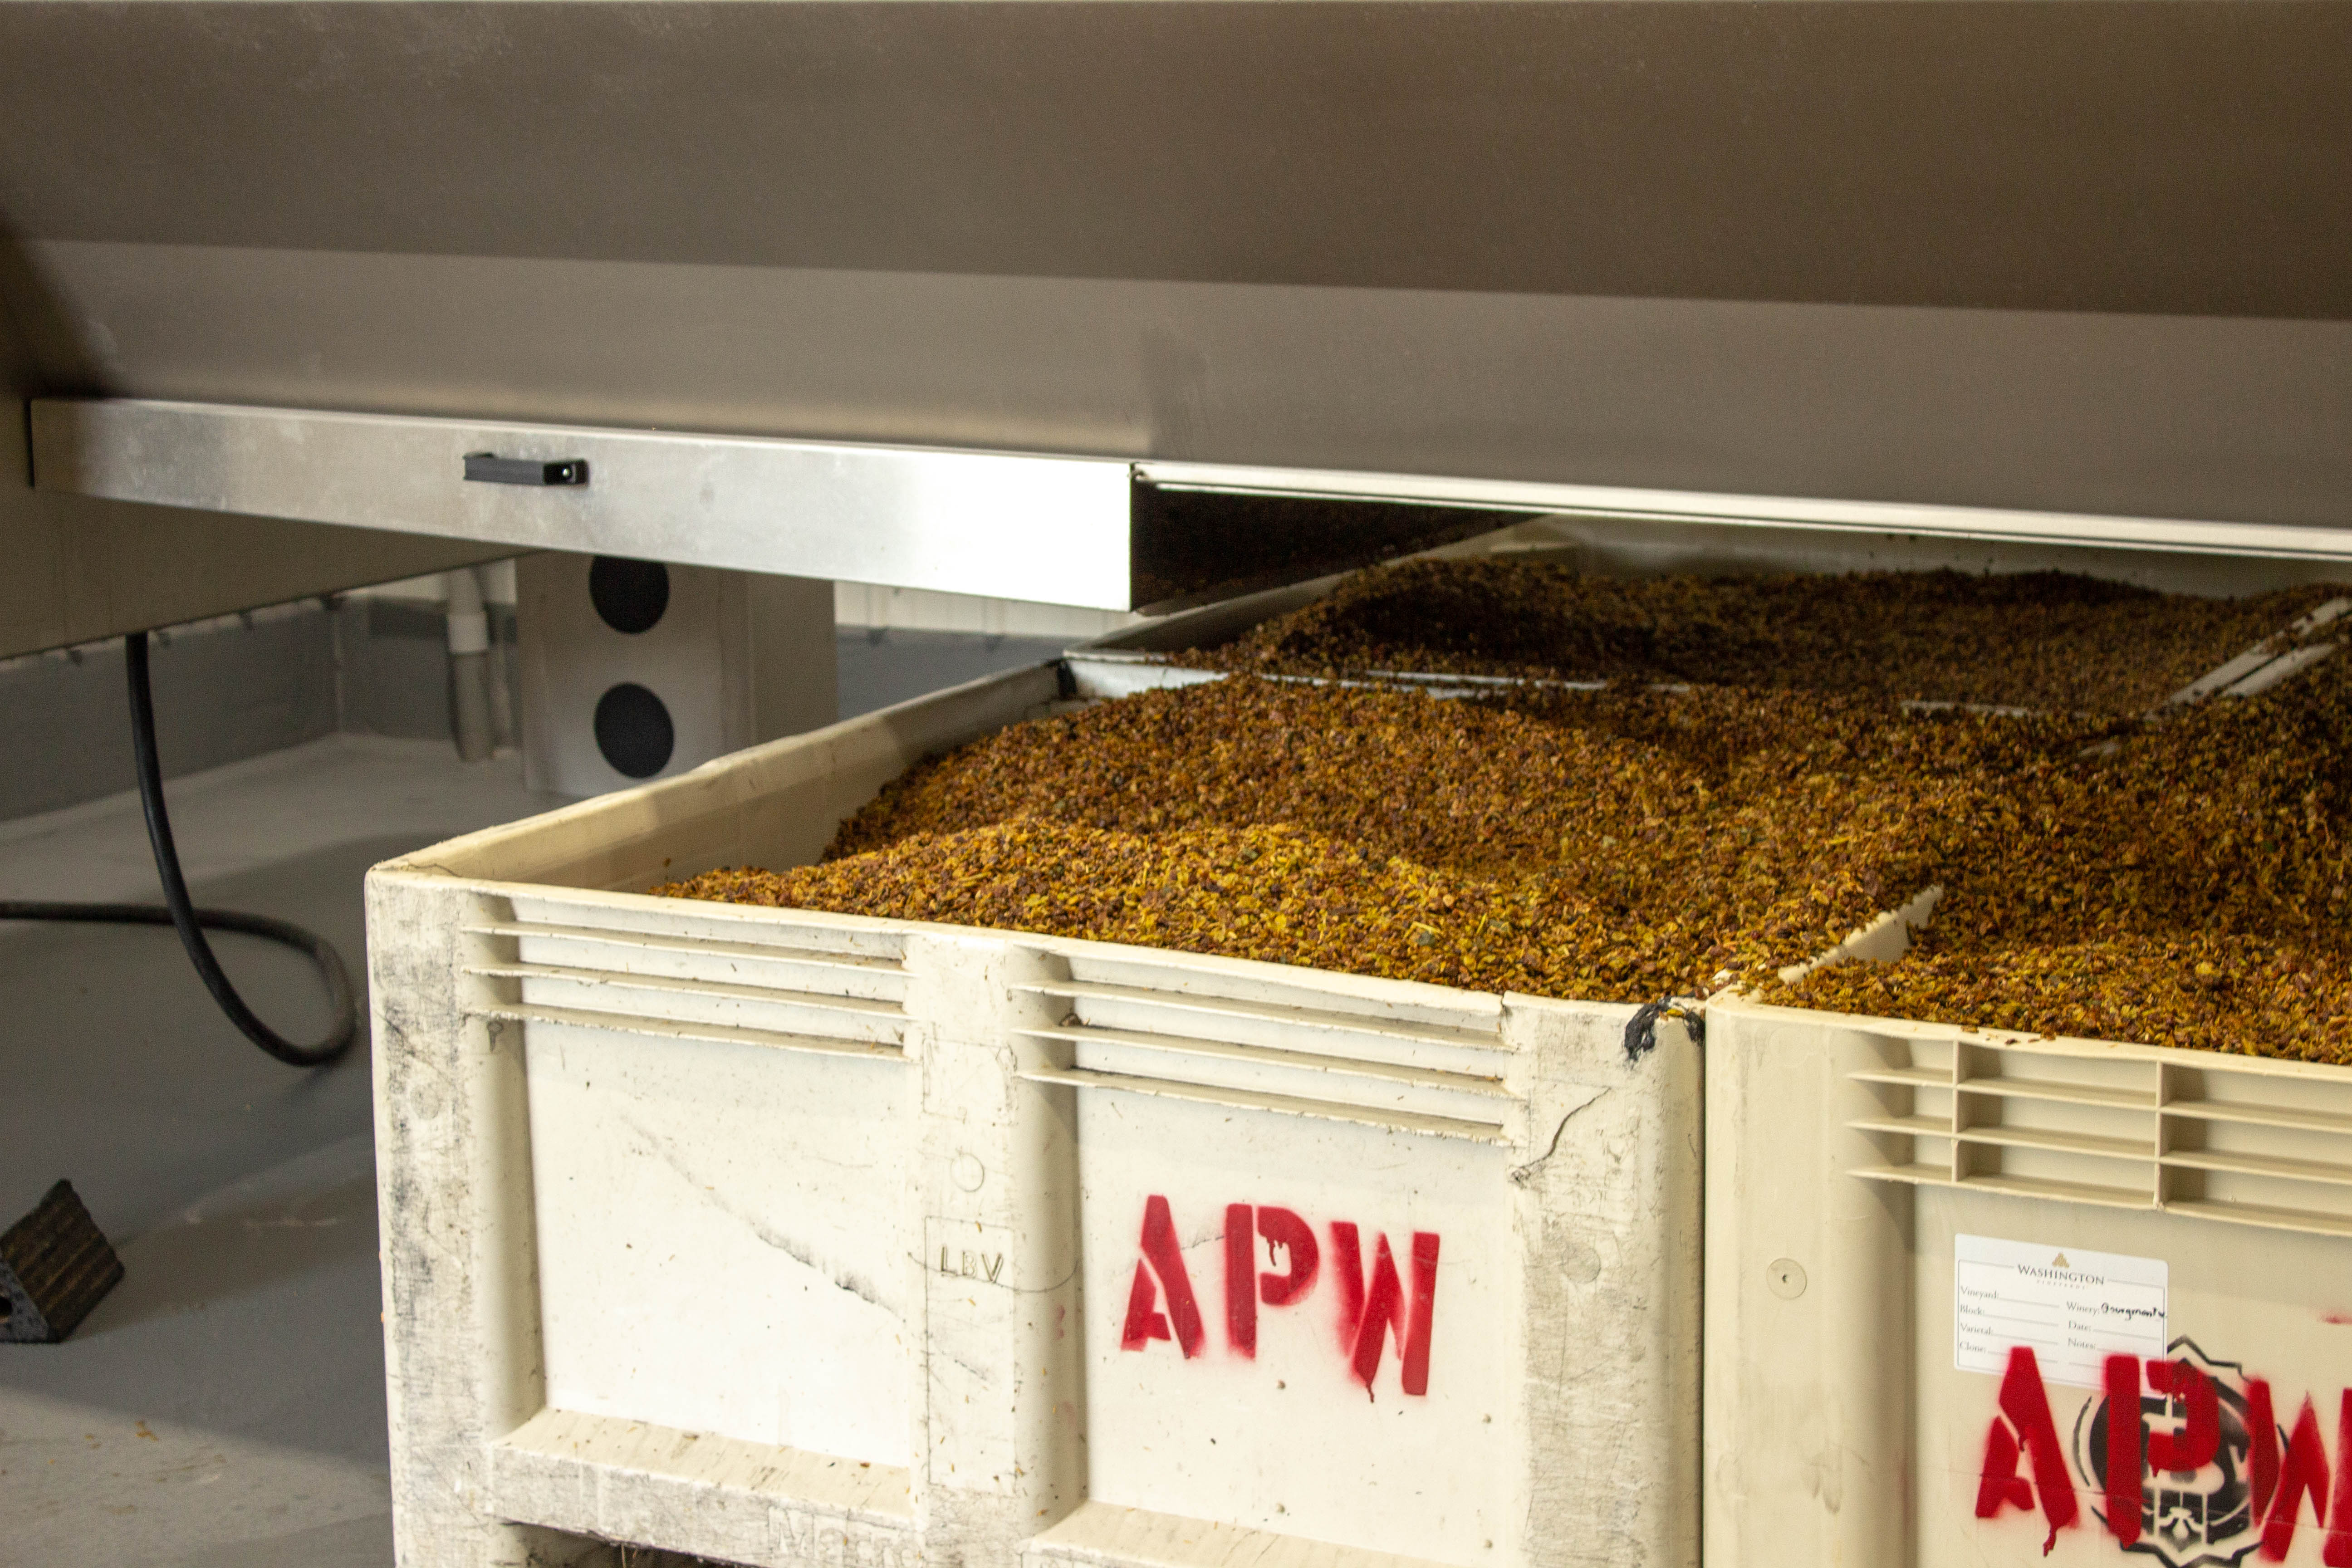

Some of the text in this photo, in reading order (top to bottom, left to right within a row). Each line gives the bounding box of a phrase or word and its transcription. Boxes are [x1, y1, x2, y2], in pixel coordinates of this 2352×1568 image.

[940, 1245, 1004, 1284] LBV
[2018, 1264, 2105, 1285] WASHINGTON
[1120, 1194, 1441, 1399] APW
[1960, 1286, 1999, 1300] Vineyard:
[1960, 1304, 1985, 1315] Block:
[2067, 1301, 2099, 1317] Winery:
[1960, 1323, 1993, 1336] Varietal:
[2068, 1320, 2091, 1332] Date:
[1960, 1341, 1986, 1353] Clone:
[2068, 1338, 2096, 1349] Notes:
[1975, 1345, 2352, 1568] APW
